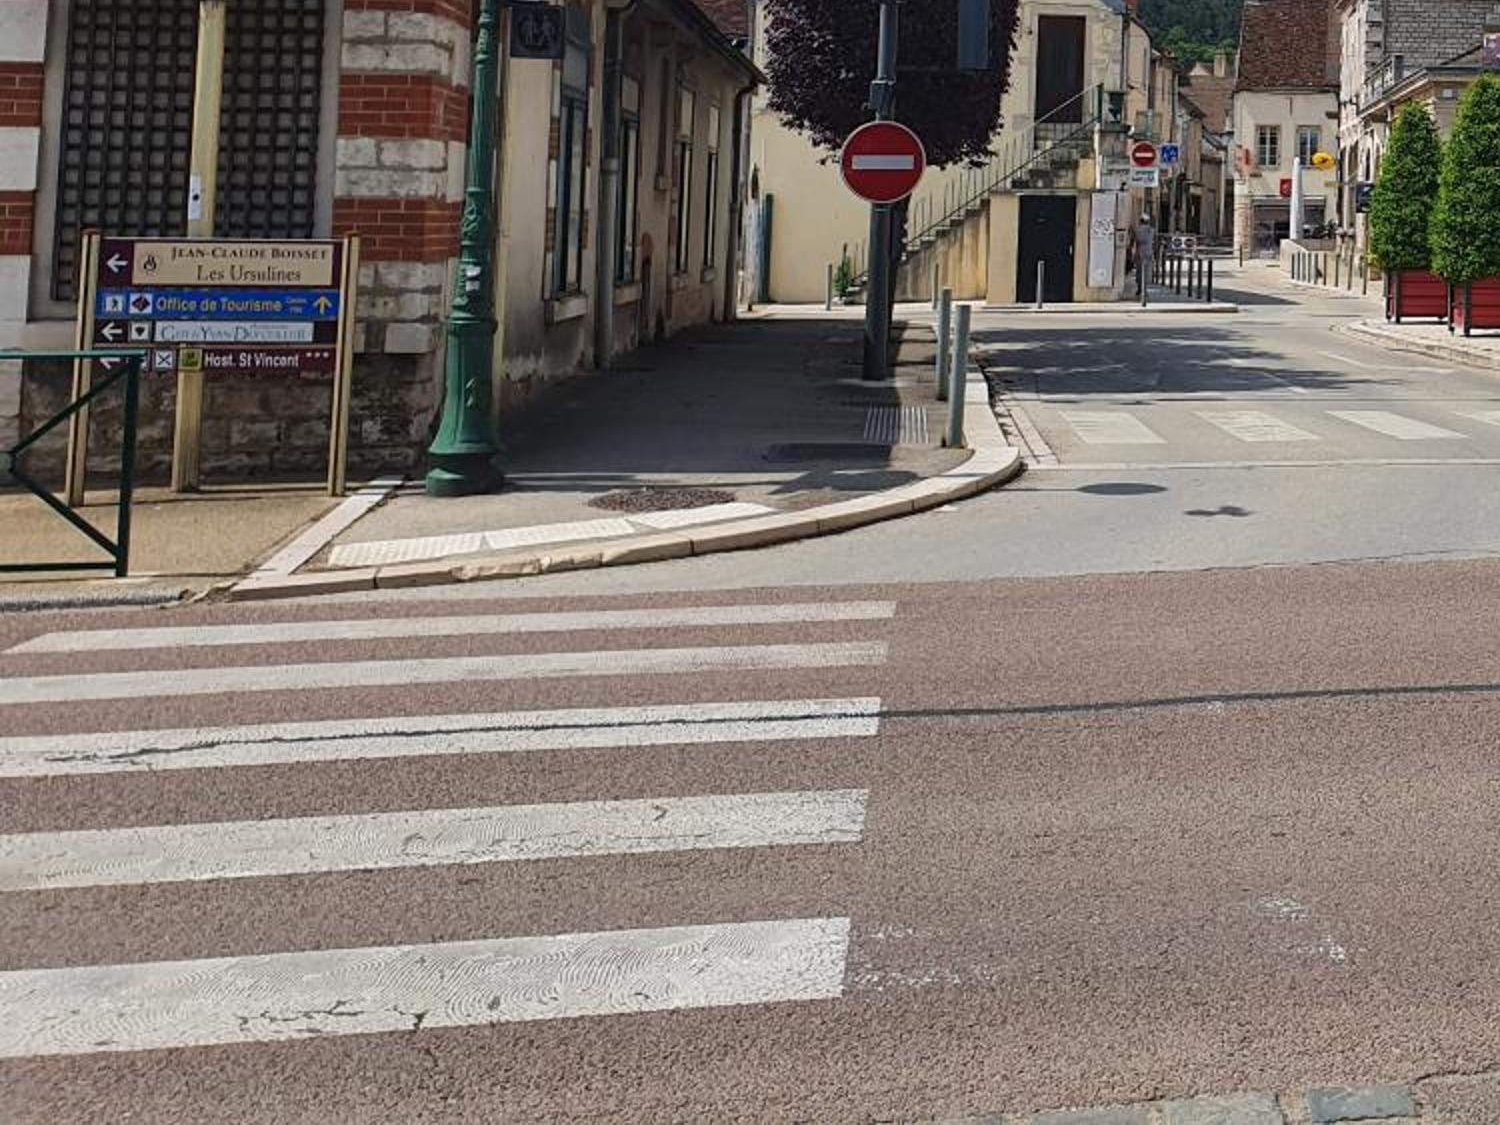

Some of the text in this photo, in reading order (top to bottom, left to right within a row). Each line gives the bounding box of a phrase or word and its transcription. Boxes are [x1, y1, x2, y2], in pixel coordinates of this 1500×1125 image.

[196, 265, 302, 282] Les Ursulines
[156, 296, 196, 312] Office
[200, 296, 216, 311] de
[219, 296, 283, 312] Tourisme
[253, 353, 300, 368] Vincent
